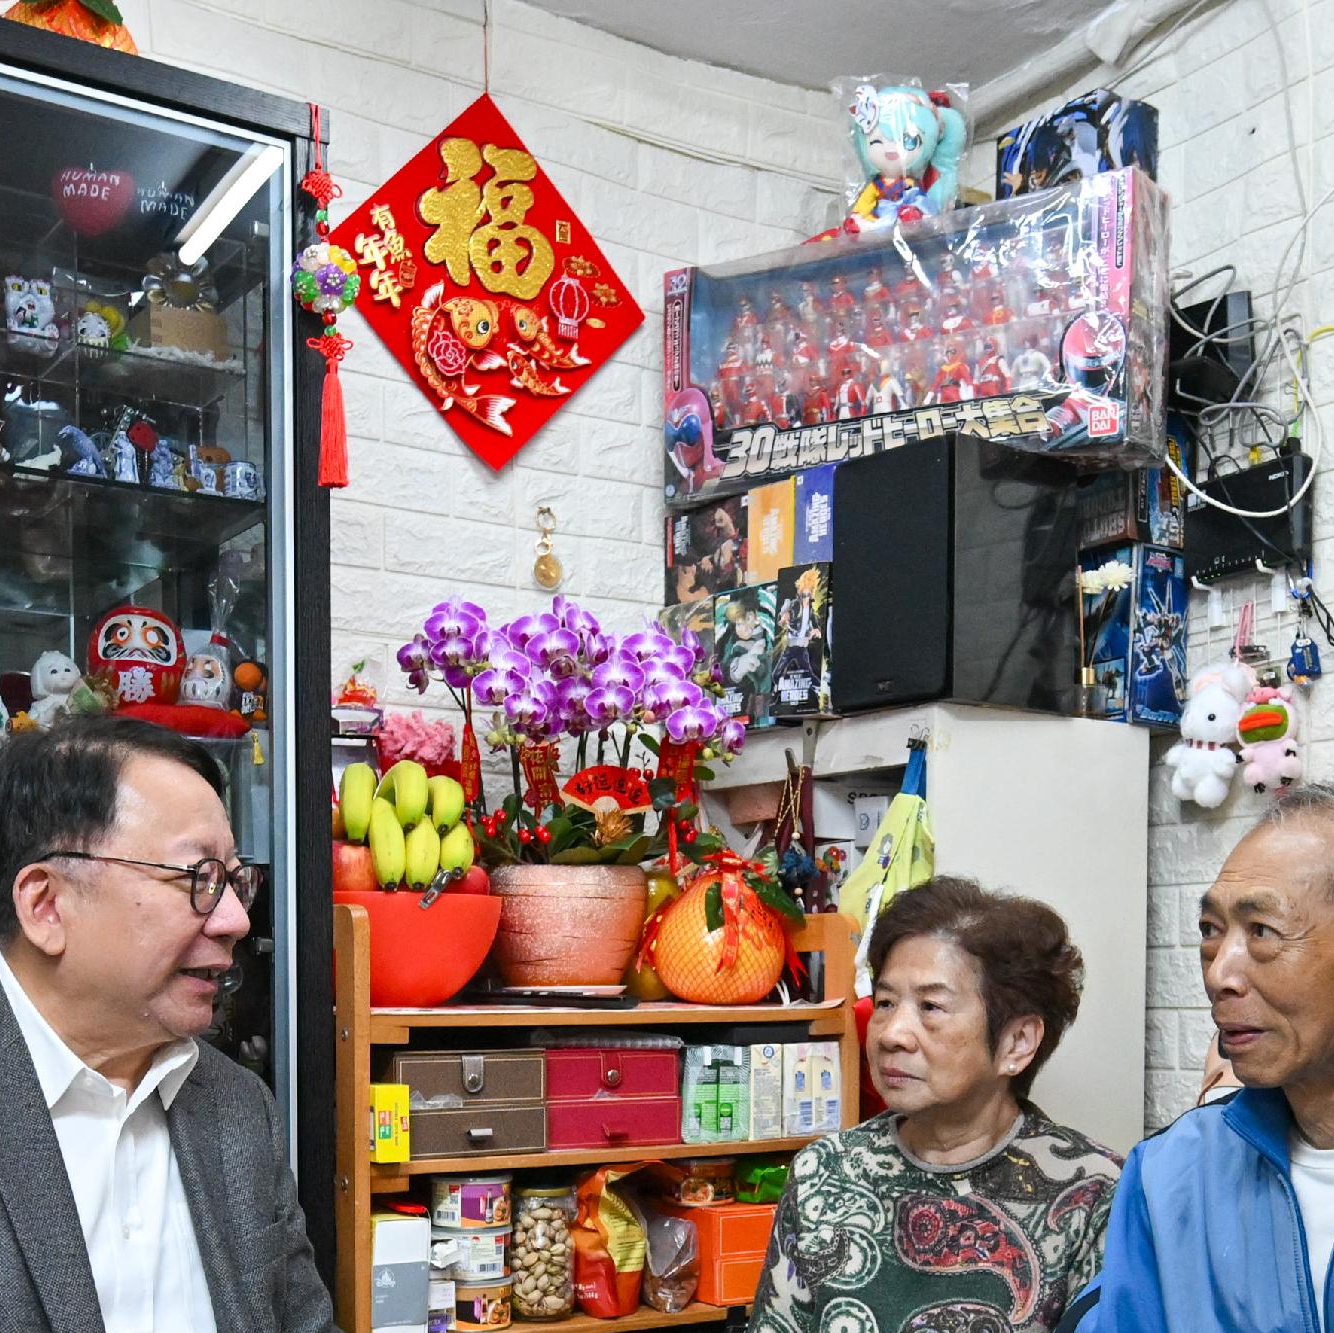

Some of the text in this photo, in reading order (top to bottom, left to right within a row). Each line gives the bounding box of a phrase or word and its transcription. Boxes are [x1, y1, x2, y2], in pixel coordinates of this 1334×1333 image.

[60, 169, 121, 186] HUMAN
[62, 183, 111, 200] MADE
[140, 200, 178, 221] MADE
[418, 136, 555, 300] 福
[1091, 419, 1111, 432] DAI
